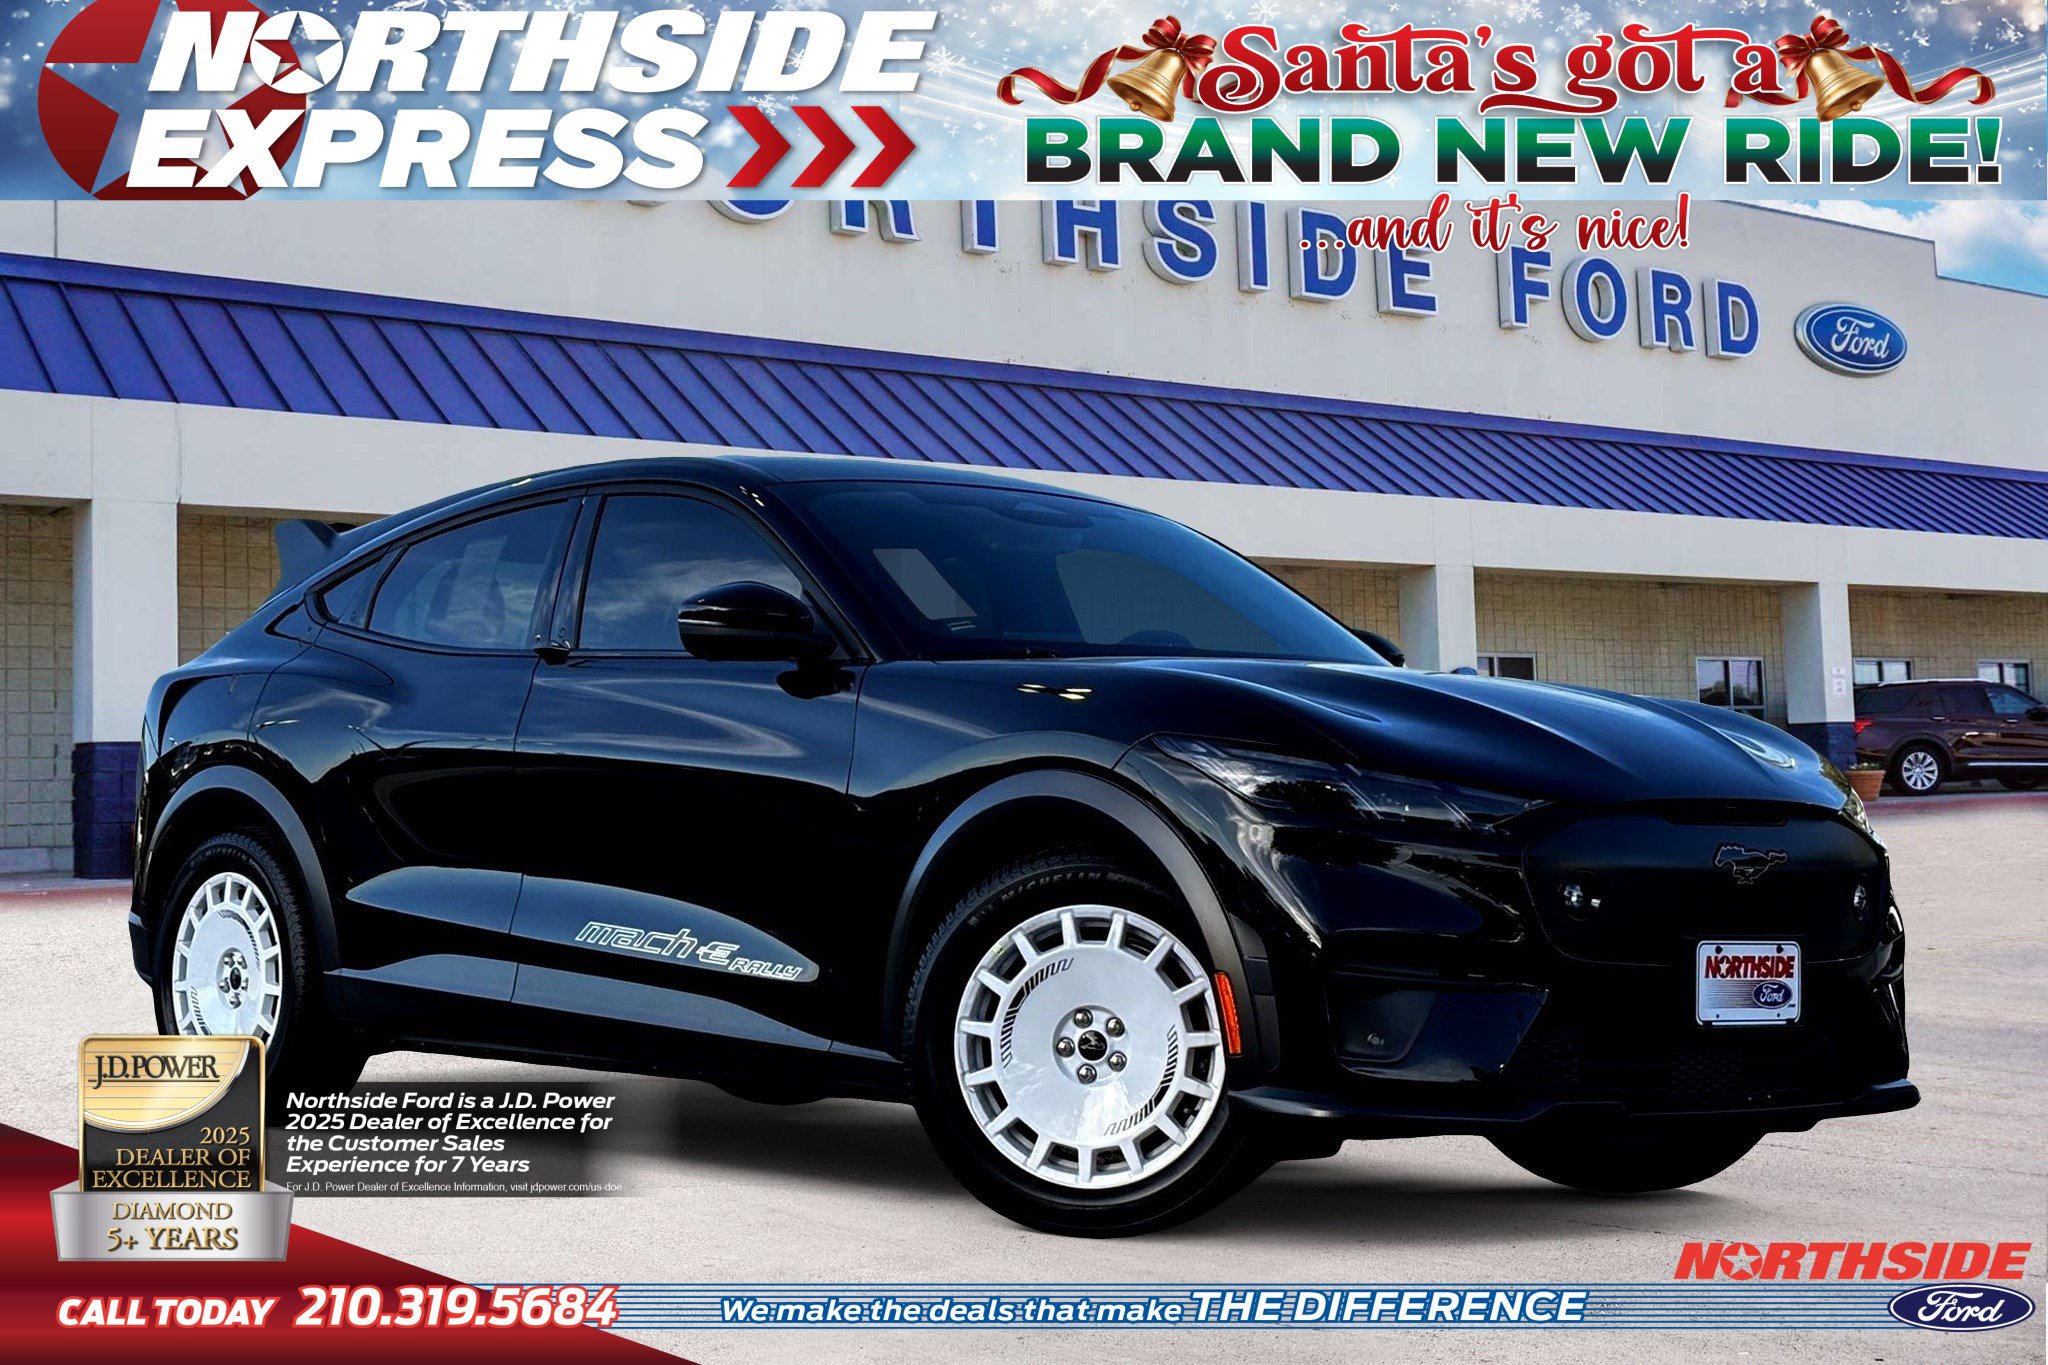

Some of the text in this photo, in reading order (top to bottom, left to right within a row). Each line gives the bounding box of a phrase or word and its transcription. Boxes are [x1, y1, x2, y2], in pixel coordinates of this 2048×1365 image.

[628, 200, 1761, 359] THSIDE FORD
[1829, 315, 1891, 361] Ford
[729, 957, 803, 981] RALLY
[1704, 955, 1796, 979] NORTHSIDE
[1759, 983, 1785, 1003] Ford
